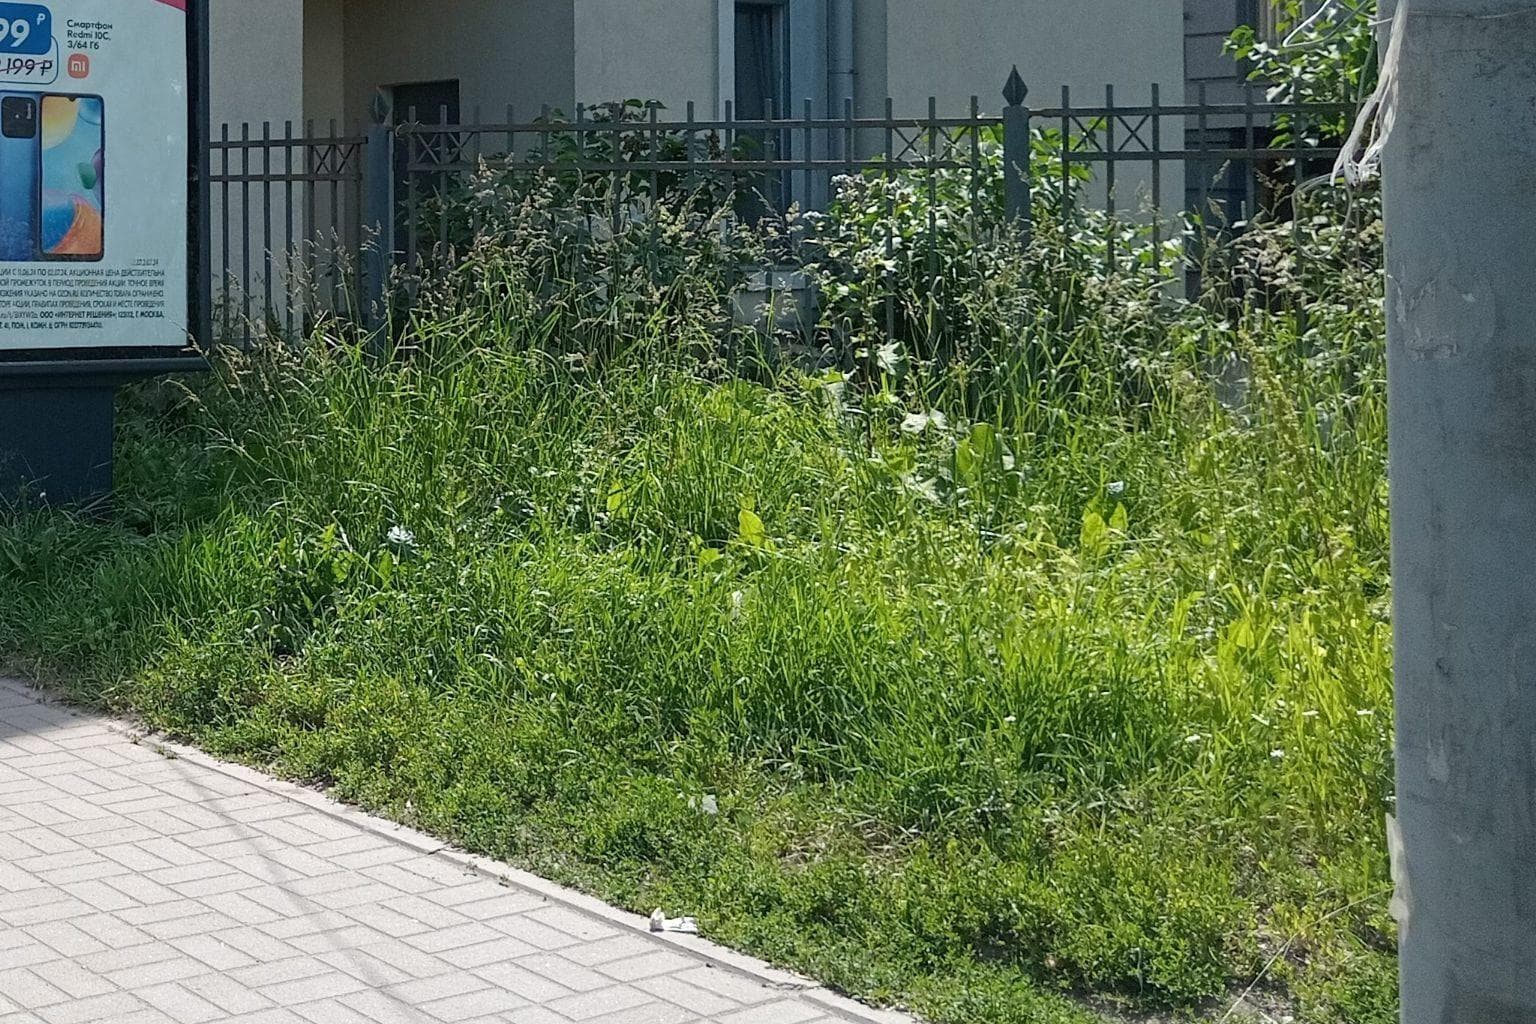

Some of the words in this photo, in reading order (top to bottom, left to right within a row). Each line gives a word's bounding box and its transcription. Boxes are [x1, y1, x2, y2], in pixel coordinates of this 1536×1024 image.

[67, 19, 113, 31] Смартфон
[67, 29, 93, 39] Redmi
[67, 40, 88, 49] 3/64
[6, 58, 36, 75] 199
